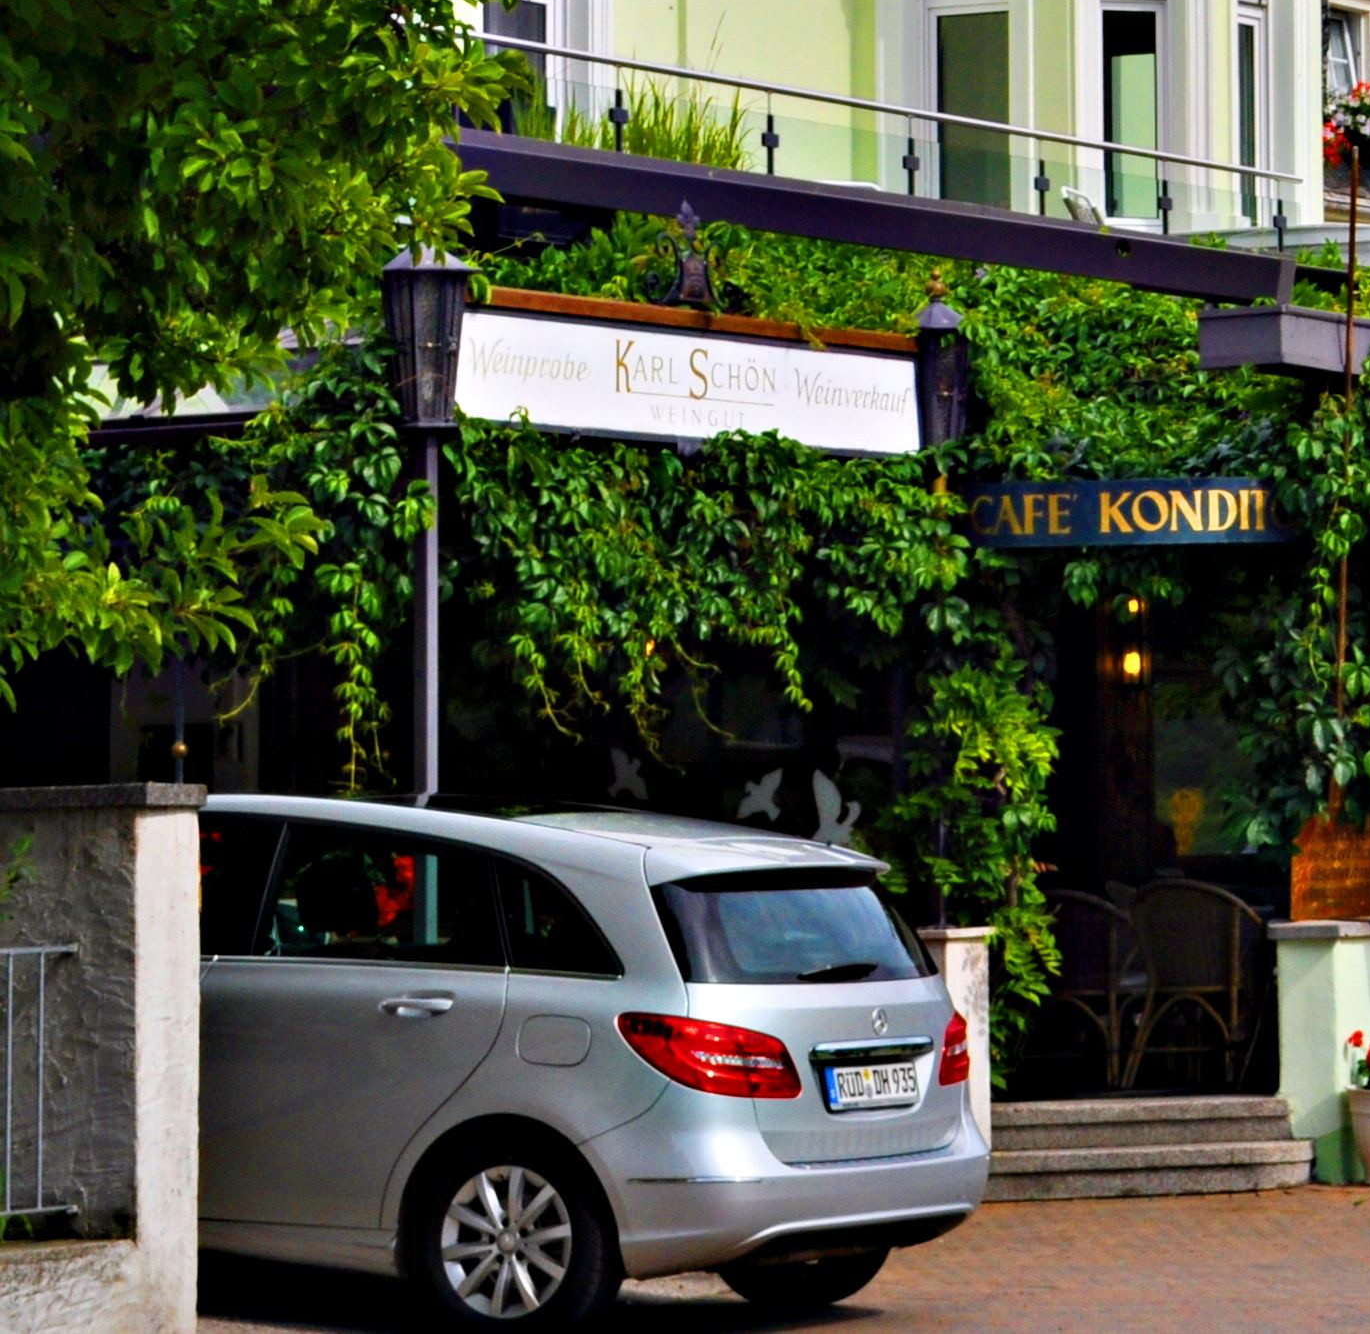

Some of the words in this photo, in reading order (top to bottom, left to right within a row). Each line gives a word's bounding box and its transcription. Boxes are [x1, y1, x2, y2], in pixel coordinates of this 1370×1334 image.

[468, 337, 591, 382] Weinprobe
[614, 338, 679, 394] KARL
[688, 348, 777, 401] SCHÖN
[794, 367, 912, 417] Weinverkauf
[649, 403, 745, 429] WEINGUT
[837, 1071, 865, 1098] RÜD
[872, 1068, 892, 1095] DH
[891, 1067, 916, 1093] 935
